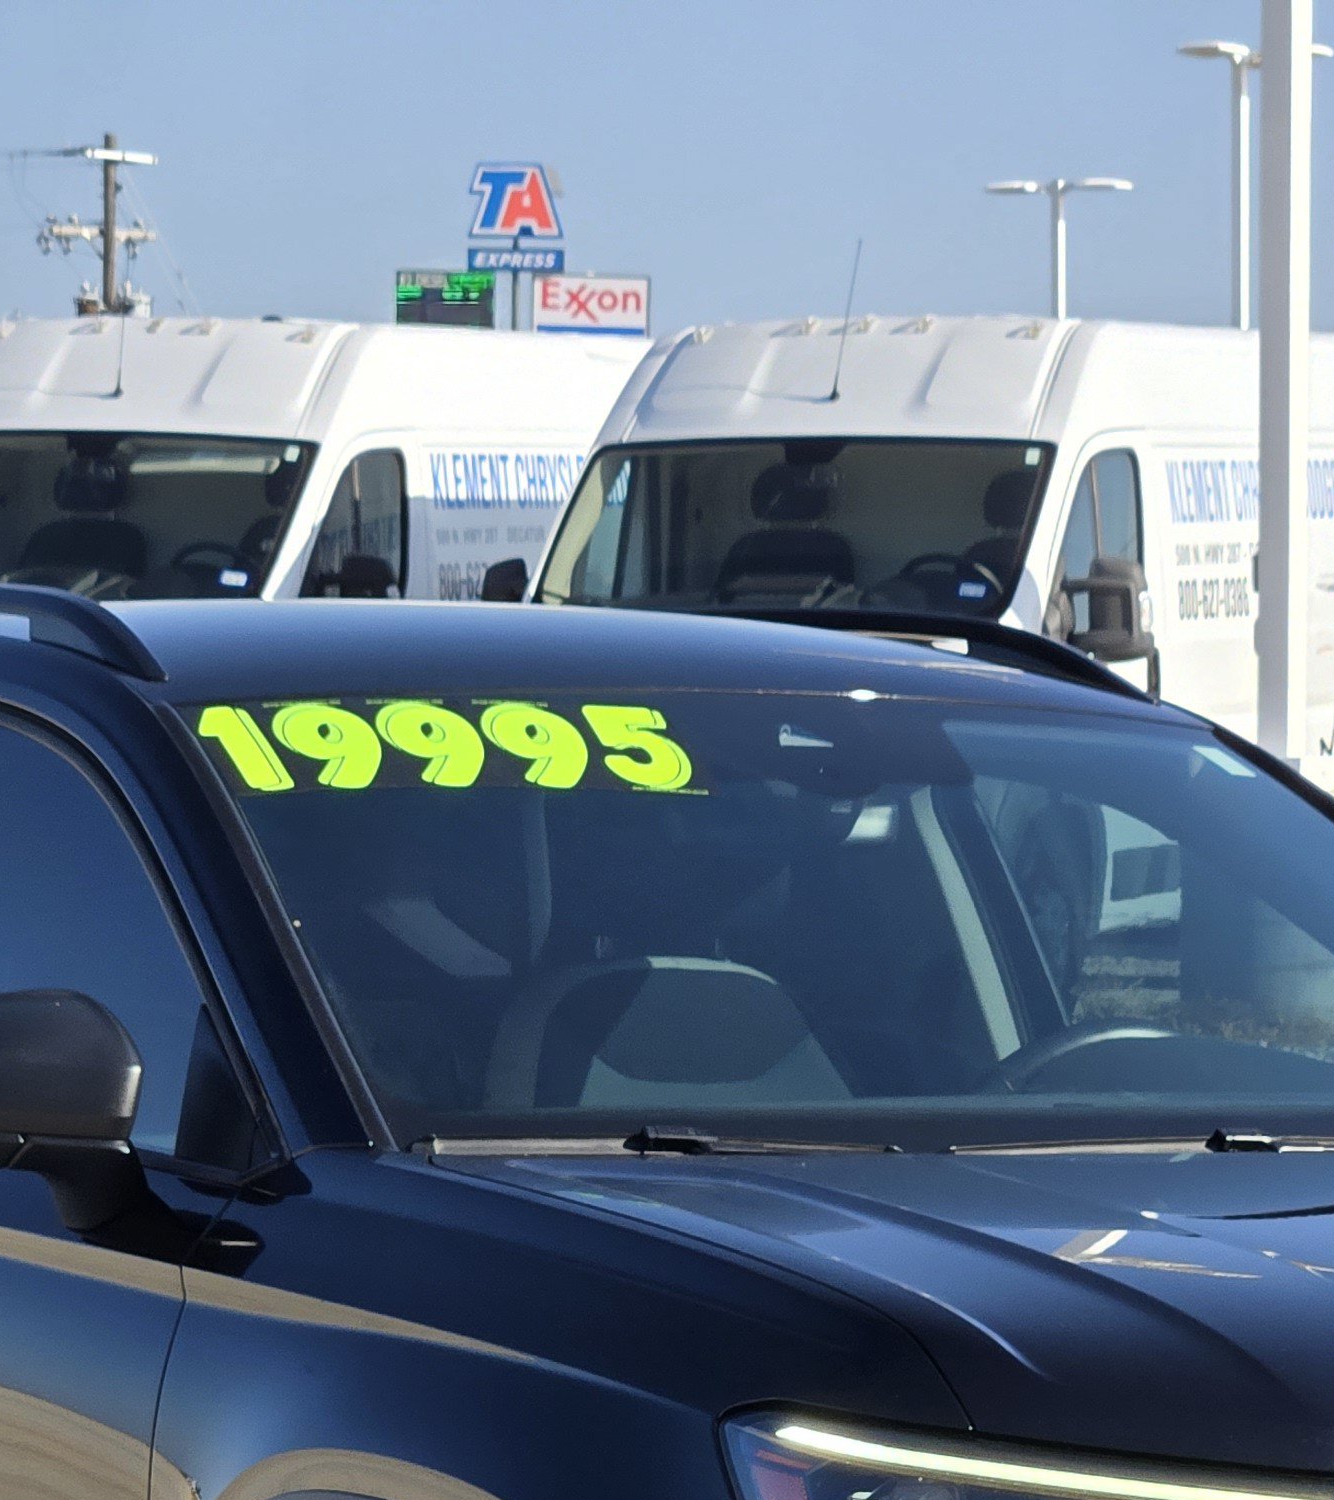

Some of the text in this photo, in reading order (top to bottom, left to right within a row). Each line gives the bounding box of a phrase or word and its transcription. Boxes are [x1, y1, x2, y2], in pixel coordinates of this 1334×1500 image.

[477, 170, 555, 231] TA
[471, 252, 557, 269] EXPRESS
[540, 279, 642, 324] Exxon
[429, 453, 512, 510] KLEMENT
[1165, 460, 1231, 524] KLEMENT
[197, 701, 692, 792] 19995
